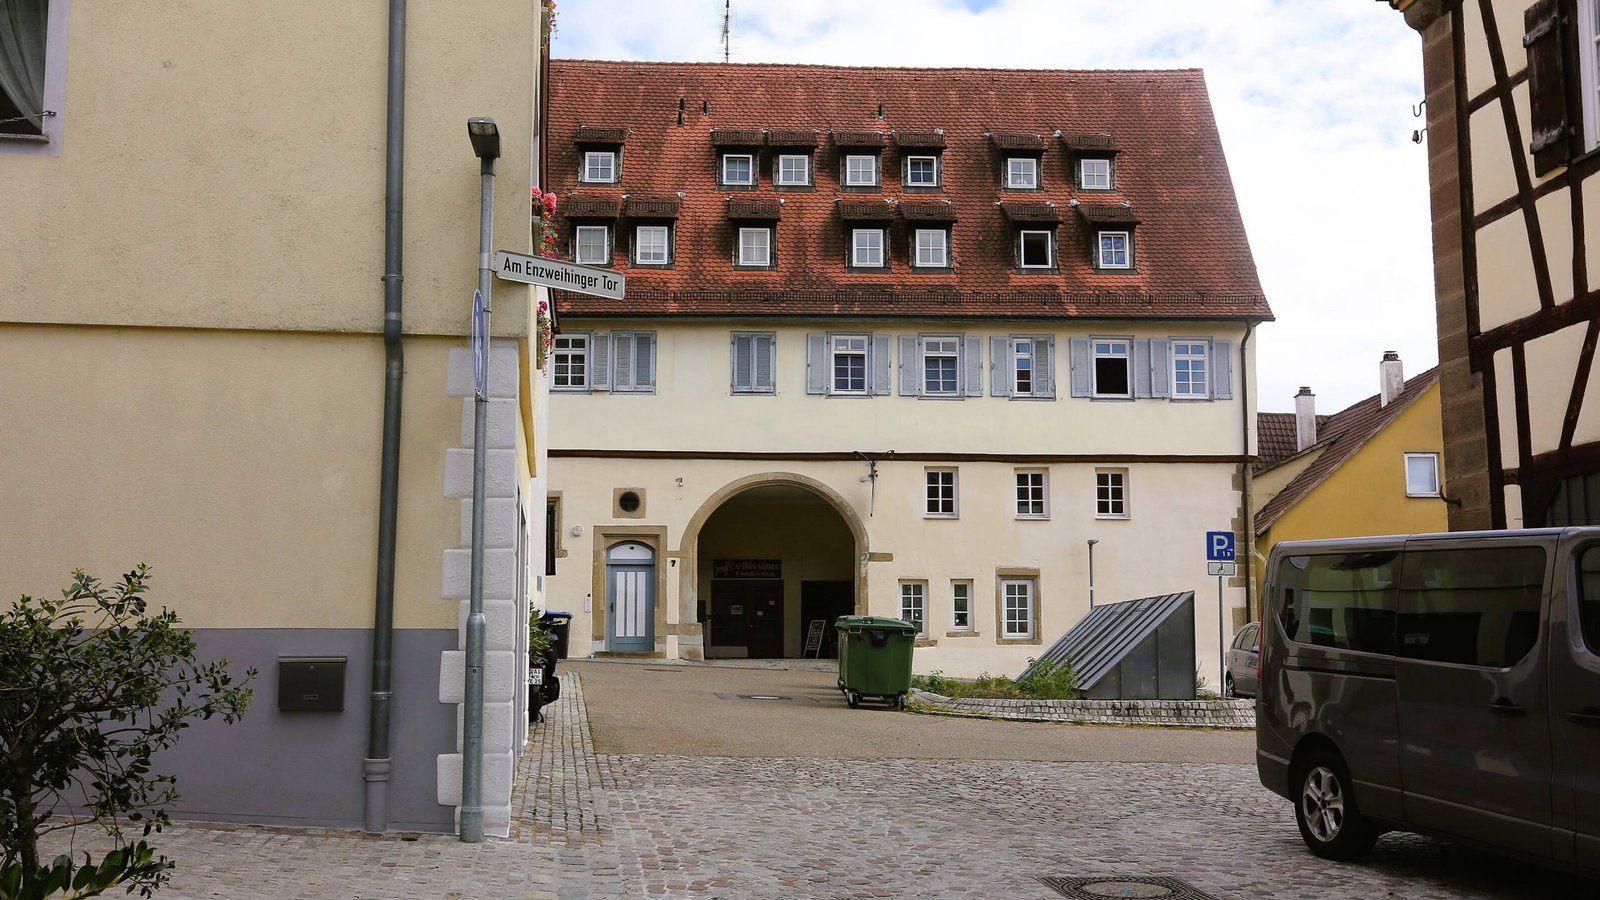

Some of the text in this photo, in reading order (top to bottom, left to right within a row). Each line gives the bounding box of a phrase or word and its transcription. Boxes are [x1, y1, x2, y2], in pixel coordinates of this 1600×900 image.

[503, 257, 618, 291] Am Enzweihinger Tor
[1213, 535, 1229, 557] P
[670, 559, 676, 568] 7
